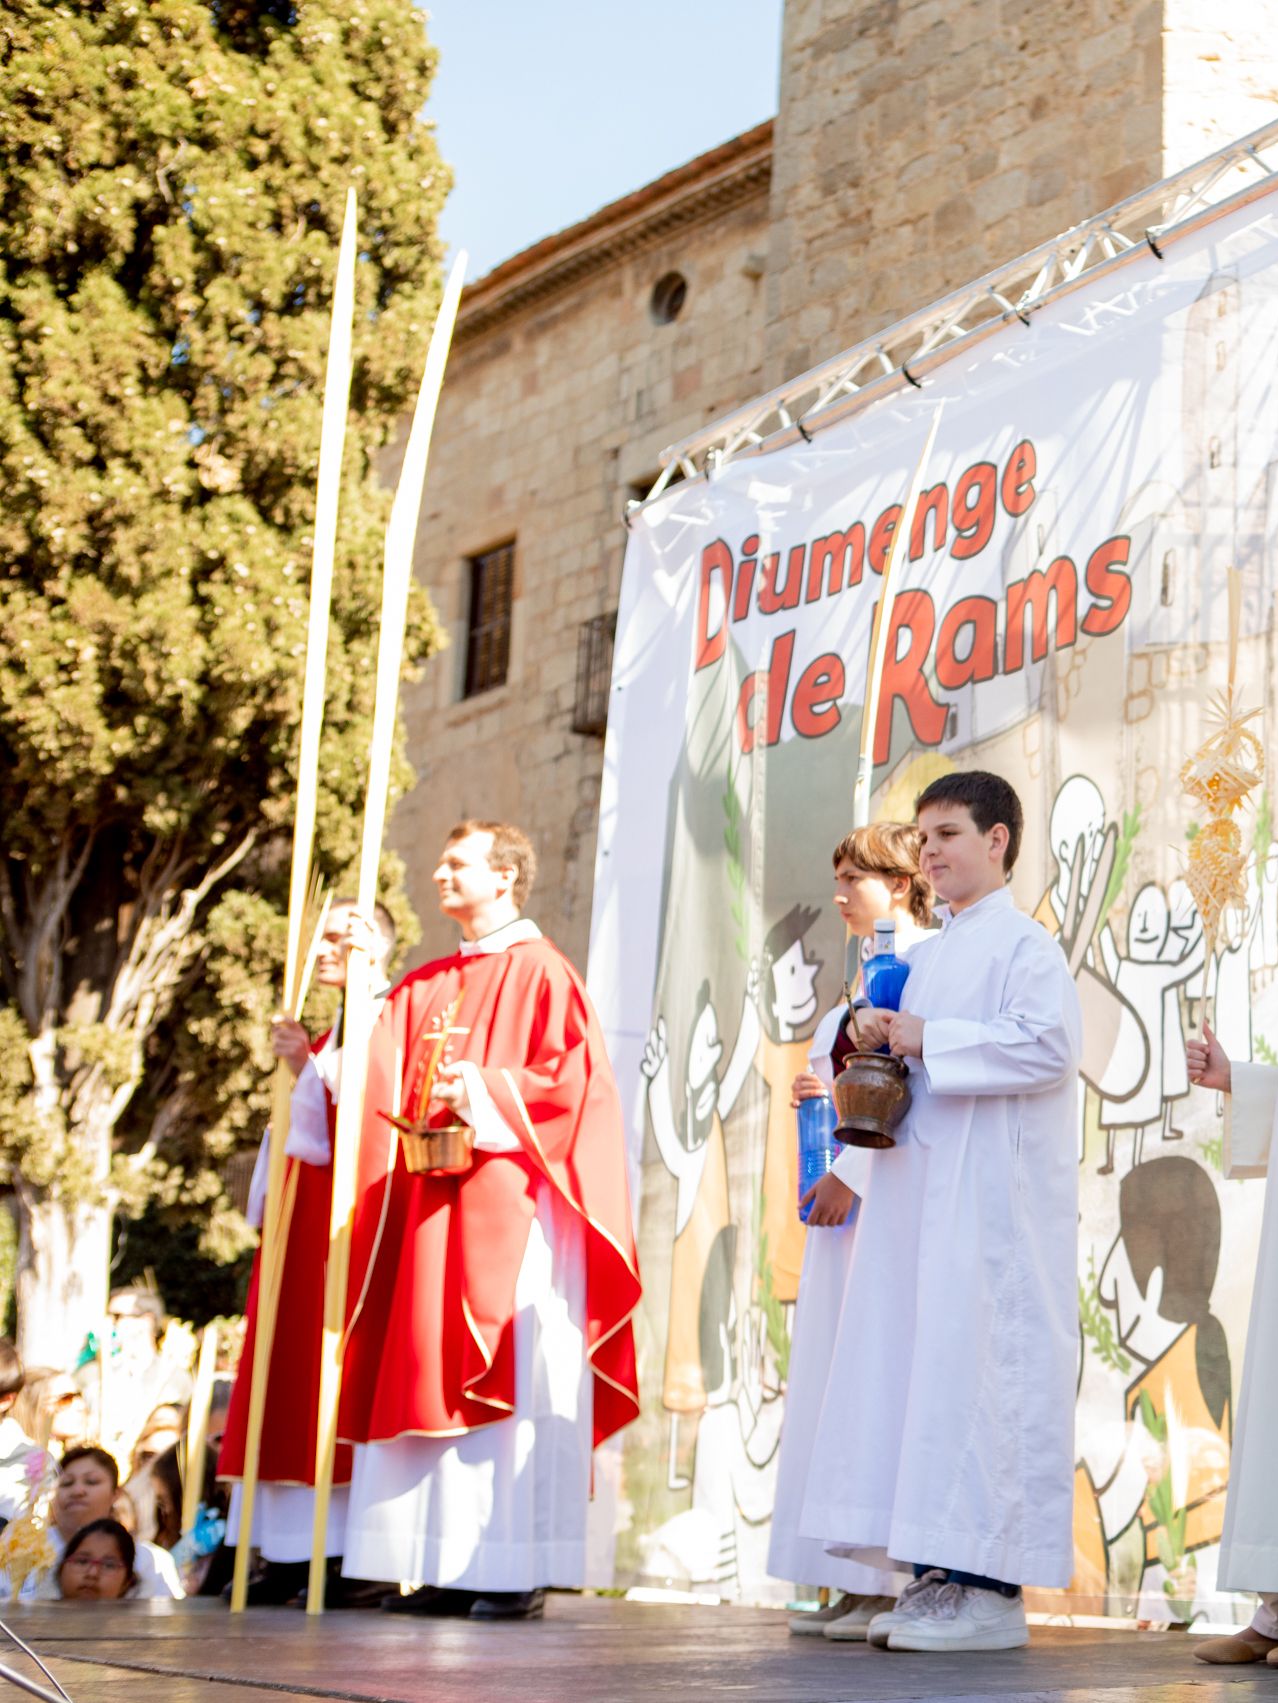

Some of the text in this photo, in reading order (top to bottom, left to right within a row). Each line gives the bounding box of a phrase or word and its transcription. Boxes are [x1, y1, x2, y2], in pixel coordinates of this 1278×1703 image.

[695, 438, 1037, 673] Diumenge
[737, 534, 1133, 767] de Rams
